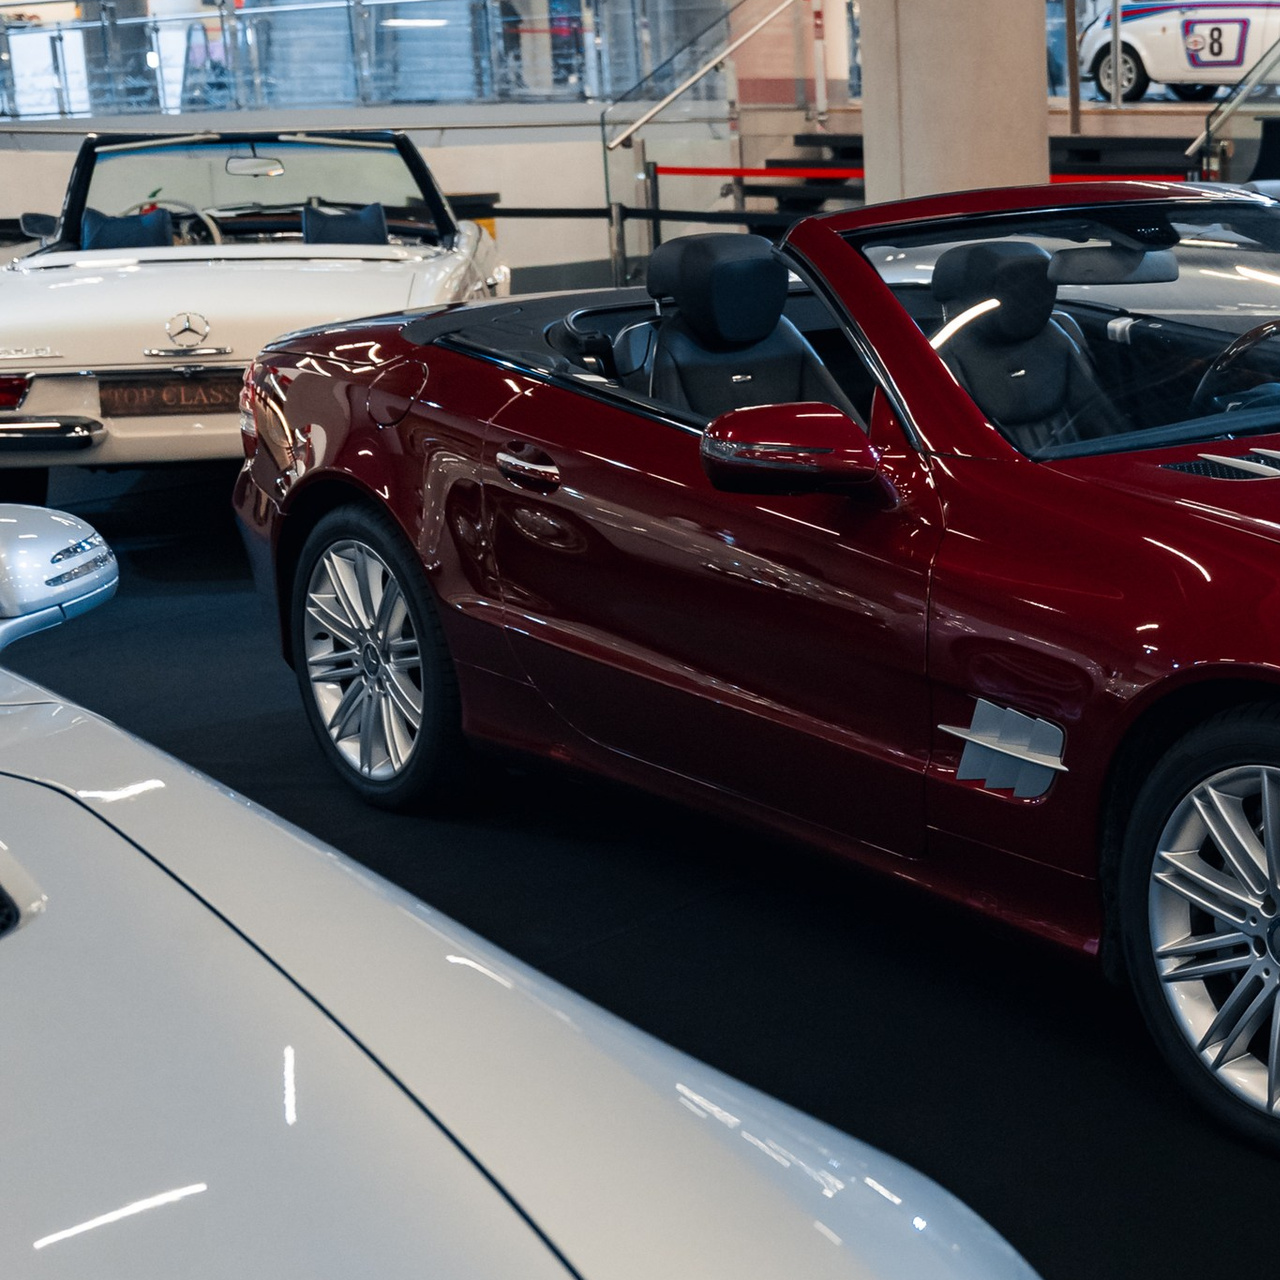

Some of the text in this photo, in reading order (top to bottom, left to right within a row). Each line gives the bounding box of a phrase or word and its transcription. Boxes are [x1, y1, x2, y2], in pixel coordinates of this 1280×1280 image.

[1209, 26, 1223, 57] 8
[108, 384, 238, 406] TOP CLASS
